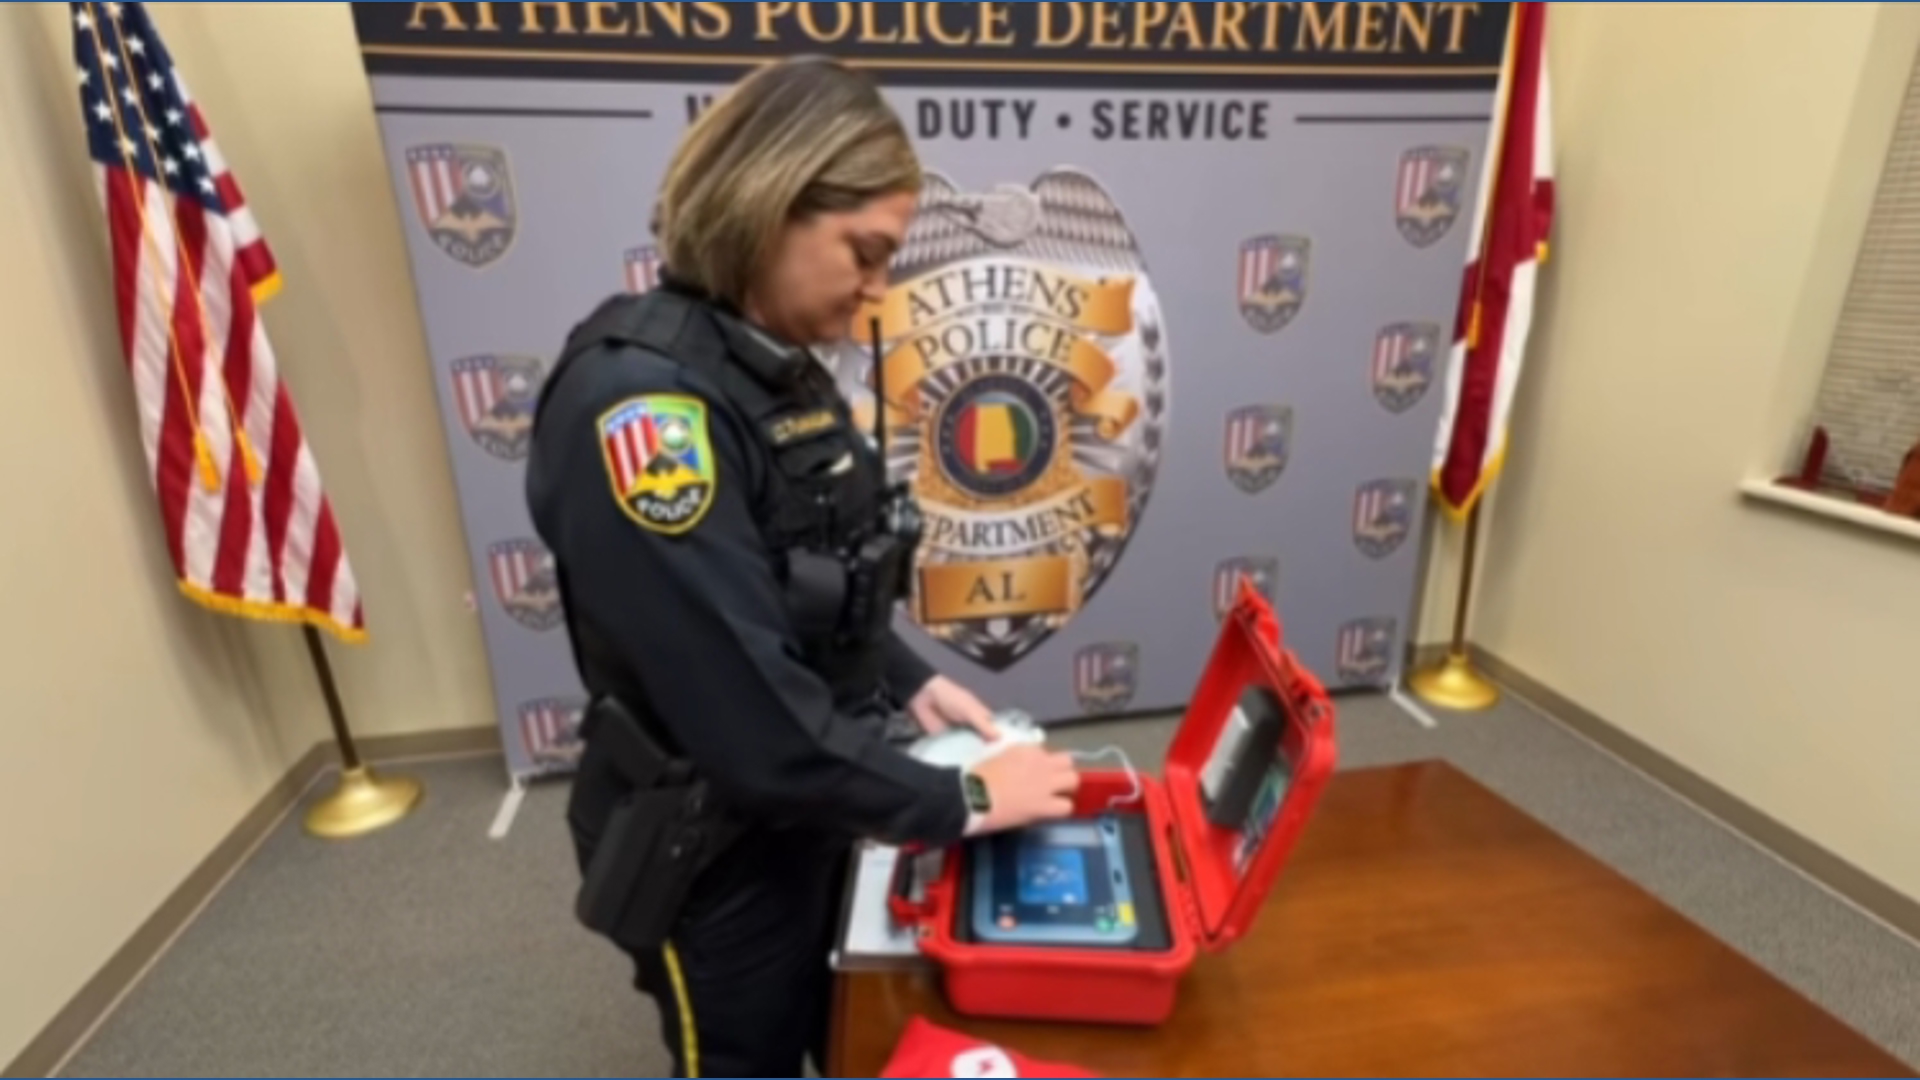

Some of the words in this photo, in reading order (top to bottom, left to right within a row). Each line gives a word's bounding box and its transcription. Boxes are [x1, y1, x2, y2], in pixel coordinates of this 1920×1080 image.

[406, 2, 731, 39] ATHENS
[754, 2, 1015, 47] POLICE
[1033, 2, 1478, 53] DEPARTMENT
[917, 99, 1036, 139] DUTY
[1092, 101, 1270, 140] SERVICE
[907, 265, 1089, 326] ATHENS
[914, 318, 1078, 369] POLICE
[636, 487, 700, 521] POLICE
[922, 488, 1096, 547] EPARTMENT
[966, 572, 1026, 605] AL
